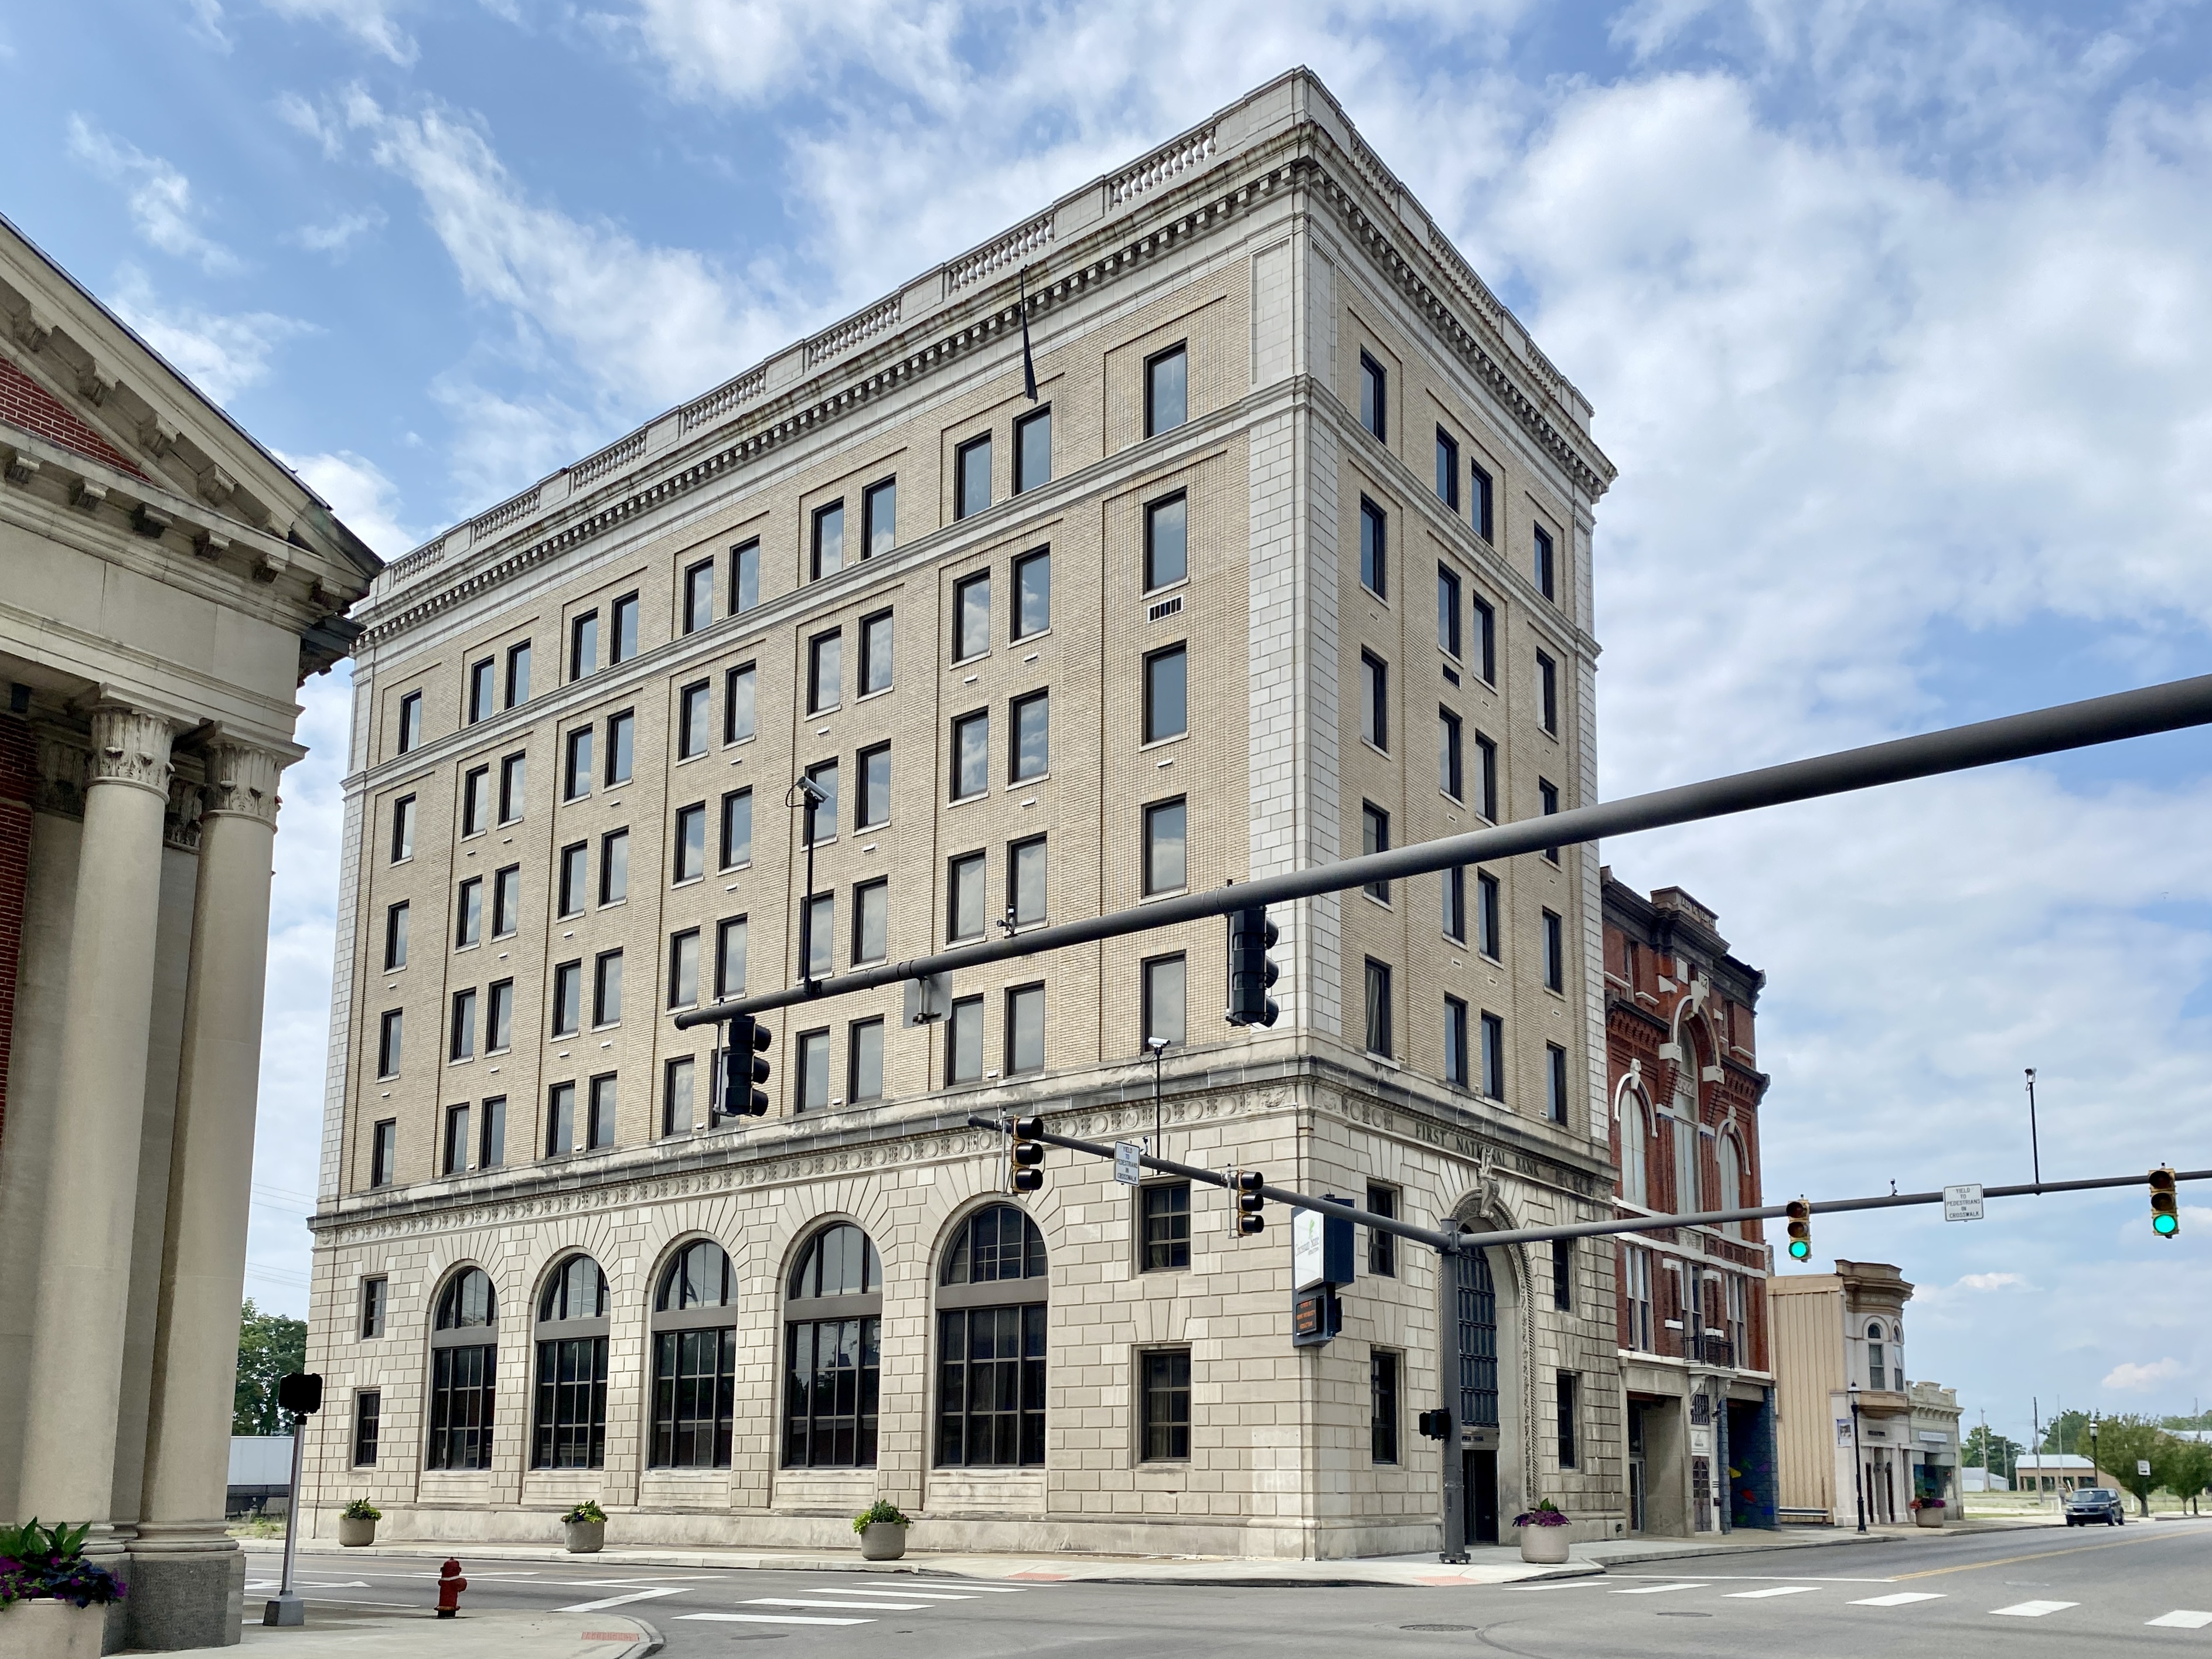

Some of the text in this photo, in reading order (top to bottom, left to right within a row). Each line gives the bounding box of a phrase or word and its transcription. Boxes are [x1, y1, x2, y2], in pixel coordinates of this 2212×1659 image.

[1415, 1122, 1446, 1147] FIRST
[1515, 1156, 1539, 1177] BANK
[1116, 1158, 1138, 1169] PEDESTRIANS
[1117, 1173, 1137, 1182] CROSSWALK
